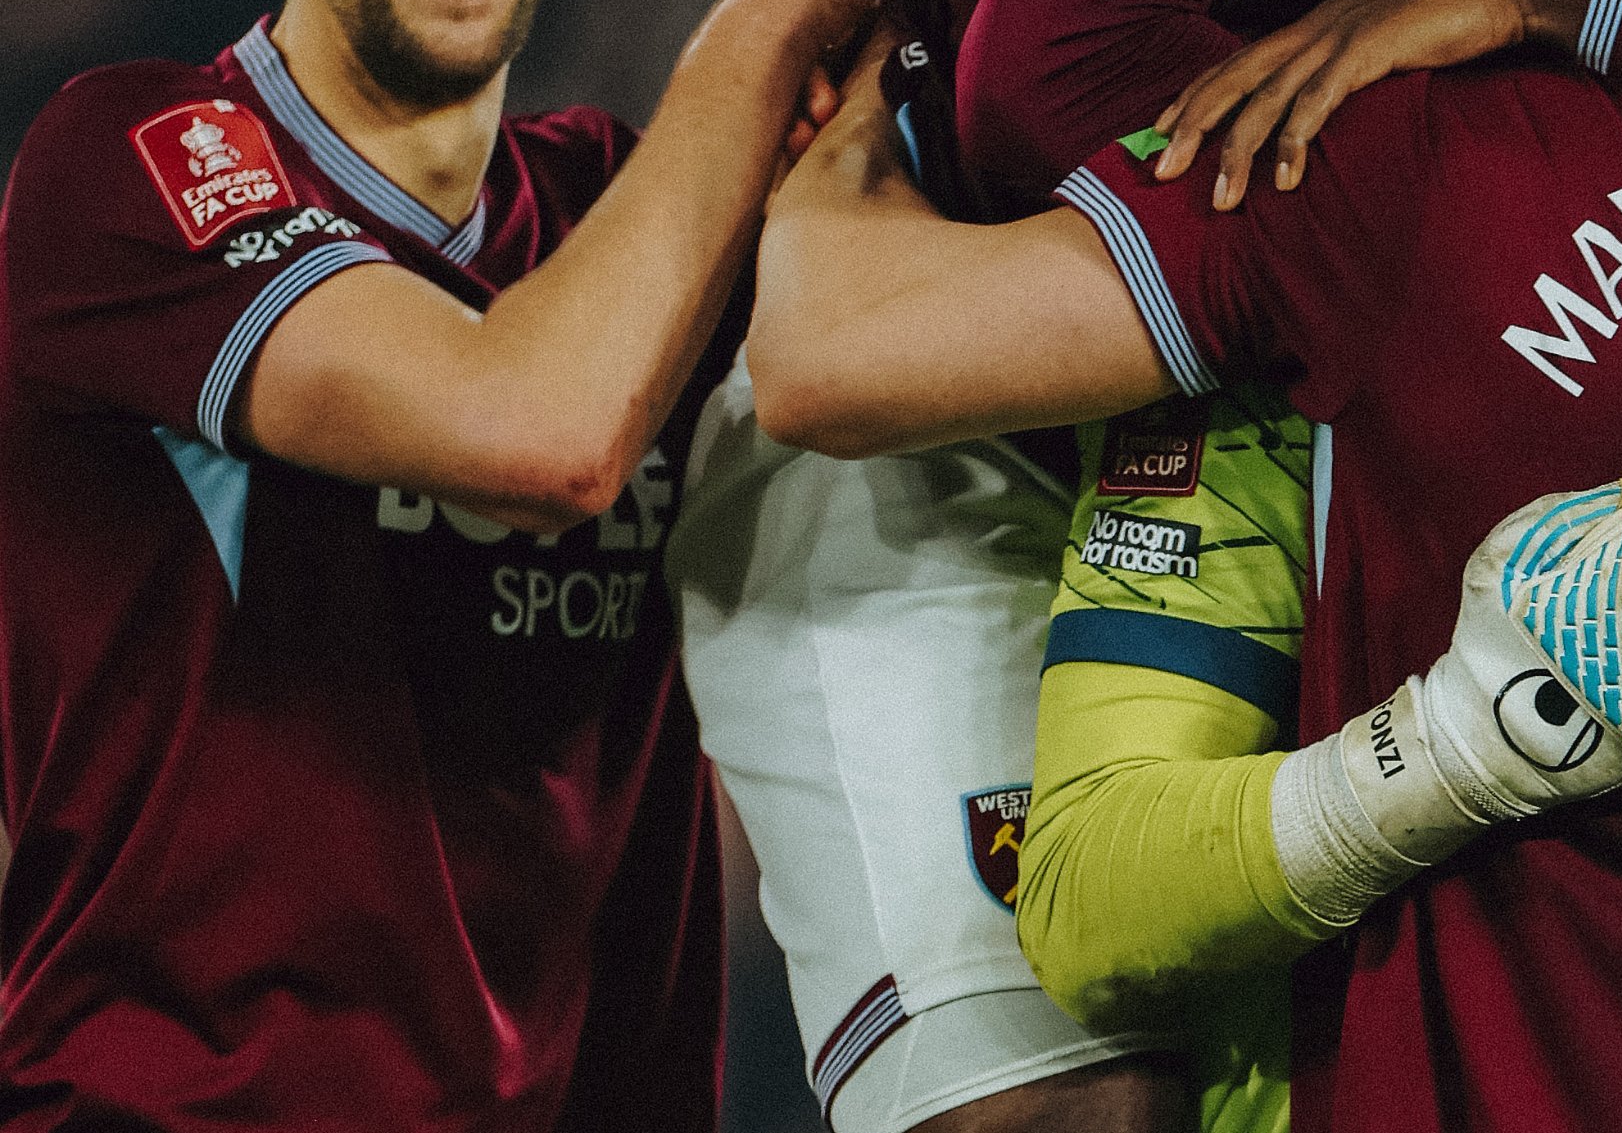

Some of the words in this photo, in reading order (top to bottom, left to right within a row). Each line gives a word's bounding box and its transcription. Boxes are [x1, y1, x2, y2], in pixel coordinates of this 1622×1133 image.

[181, 168, 274, 209] Emirates
[190, 198, 227, 228] FA
[225, 182, 279, 206] CUP
[1143, 454, 1188, 476] CUP
[1088, 511, 1118, 540] No
[1118, 519, 1186, 552] room
[1080, 537, 1113, 564] for
[975, 790, 1031, 813] WEST
[1001, 806, 1031, 821] UN
